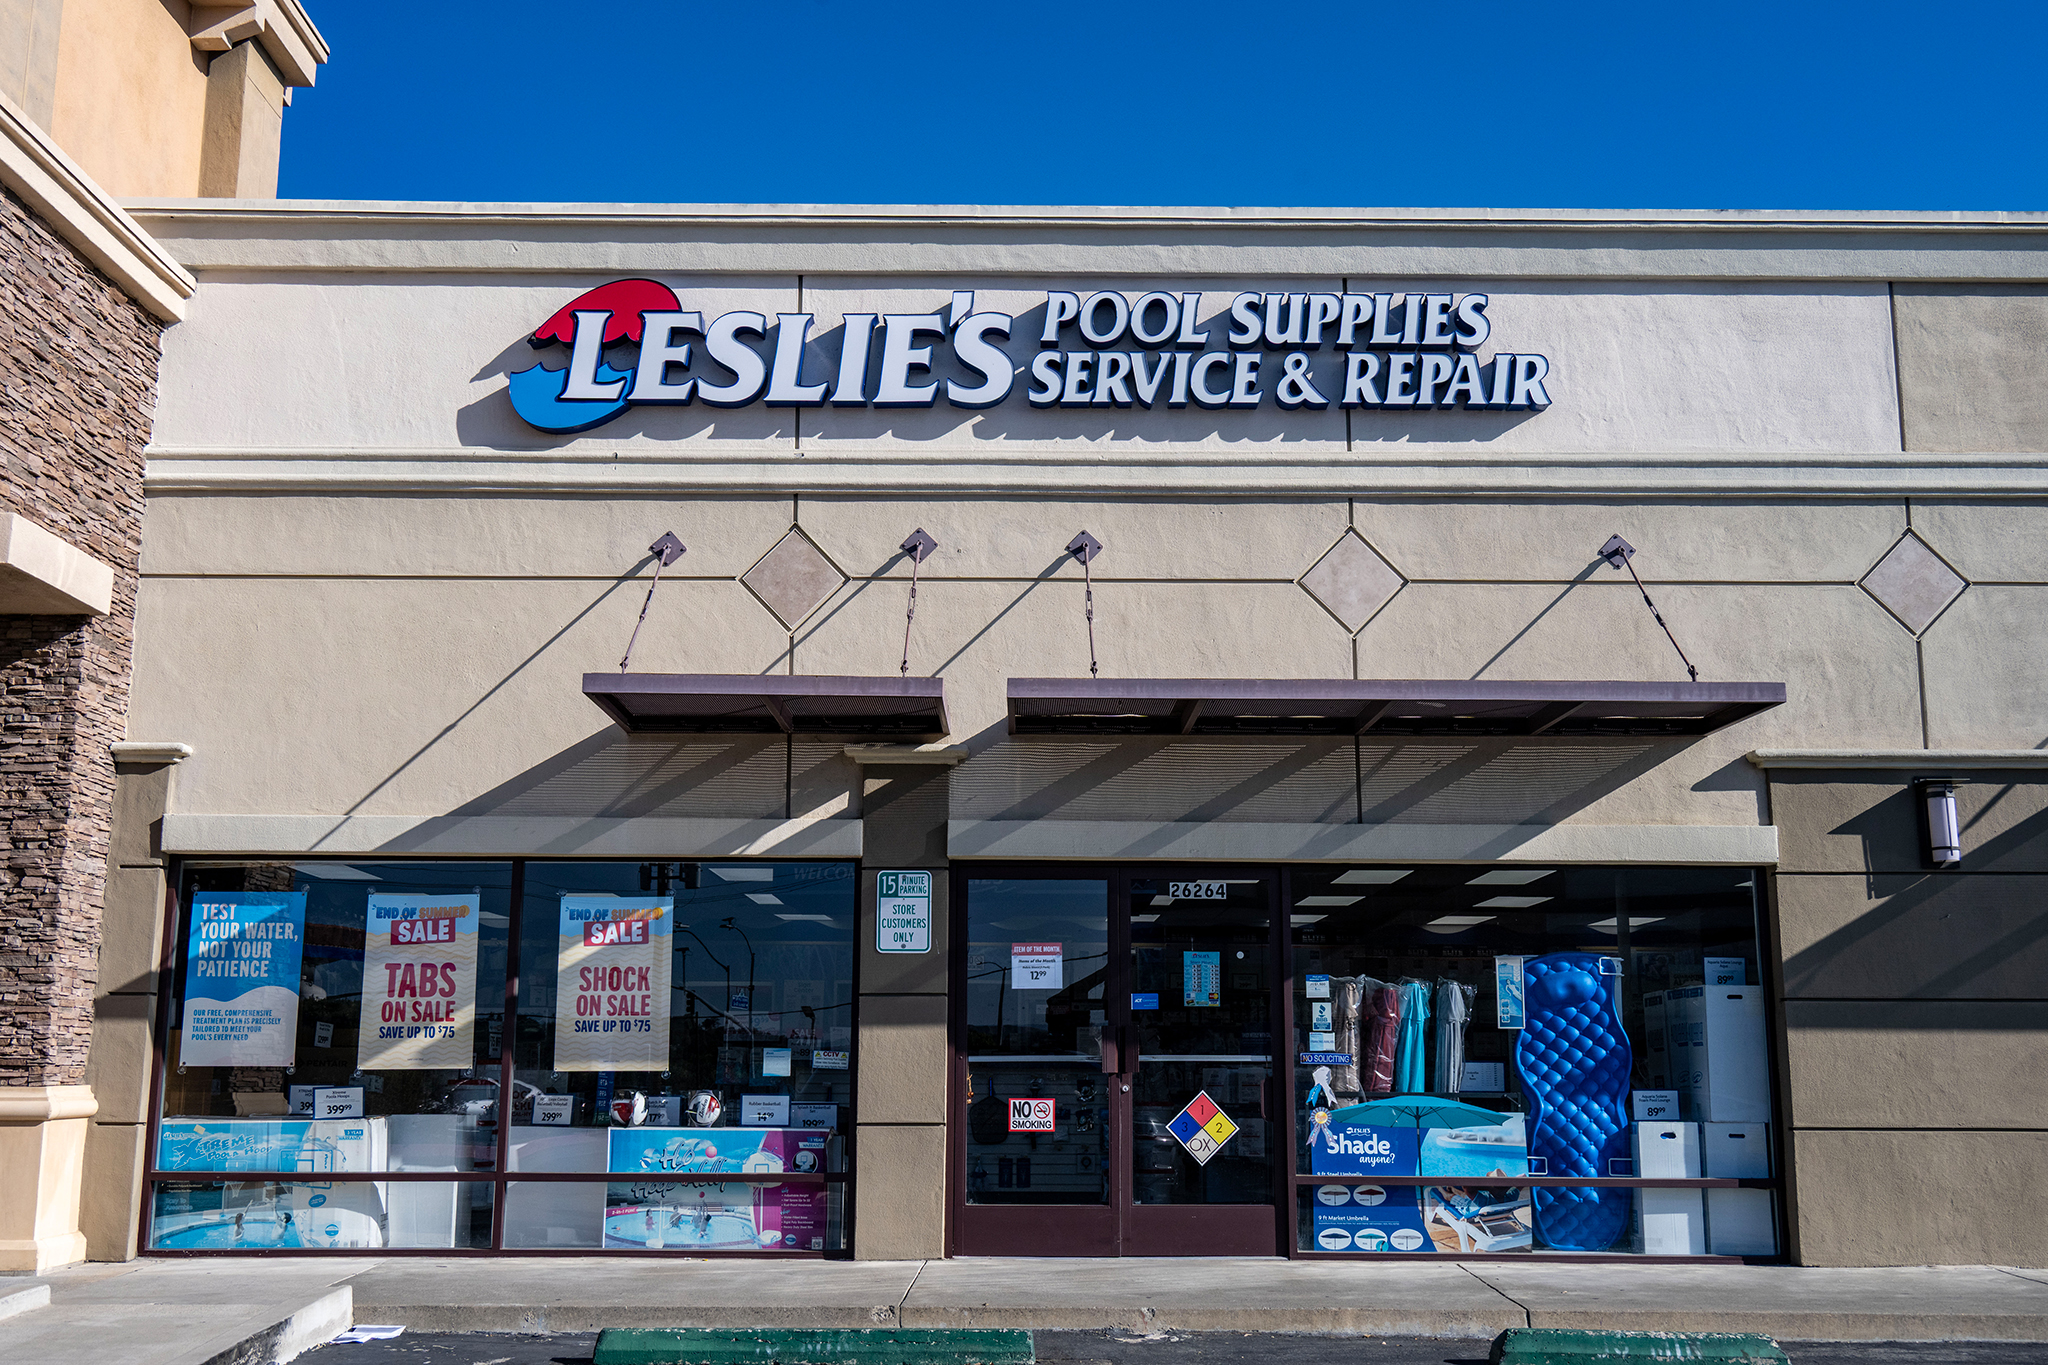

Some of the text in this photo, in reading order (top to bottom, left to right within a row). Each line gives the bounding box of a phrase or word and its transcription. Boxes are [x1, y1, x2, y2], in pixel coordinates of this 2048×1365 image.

[1040, 291, 1491, 350] POOL SUPPLIES
[558, 290, 1016, 409] LESLIE'S
[1028, 350, 1553, 411] SERVICE & REPAIR
[882, 875, 925, 894] 15 MINUTE
[900, 885, 927, 894] PARKING
[1171, 883, 1226, 898] 26264
[201, 903, 238, 920] TEST
[376, 906, 466, 920] END OF SUMMER
[568, 908, 660, 922] END OF SUMMER
[892, 904, 916, 915] STORE
[881, 918, 927, 929] CUSTOMERS
[200, 921, 299, 942] YOUR WATER,
[397, 919, 450, 943] SALE
[590, 921, 643, 944] SALE
[893, 931, 914, 943] ONLY
[198, 940, 272, 958] NOT YOUR
[197, 960, 270, 978] PATIENCE
[384, 962, 457, 998] TABS
[578, 966, 651, 992] SHOCK
[381, 1000, 456, 1022] ON SALE
[576, 994, 651, 1017] ON SALE
[193, 1009, 273, 1018] OUR FREE, COMPREHENSIVE
[192, 1017, 227, 1025] TREATMENT
[228, 1017, 243, 1025] PLAN
[574, 1019, 651, 1033] SAVE UP TO $75
[192, 1025, 221, 1033] TAILORED
[379, 1025, 455, 1039] SAVE UP TO $75
[191, 1033, 213, 1041] POOL'S
[214, 1033, 232, 1041] EVERY
[1302, 1054, 1350, 1063] NO SOLICITING
[1012, 1101, 1031, 1118] NO
[1200, 1104, 1204, 1115] 1
[1012, 1120, 1052, 1129] SMOKING
[1181, 1121, 1188, 1133] 3
[1215, 1122, 1223, 1134] 2
[1189, 1138, 1211, 1152] OX
[1327, 1133, 1391, 1155] Shade
[1359, 1153, 1396, 1167] anyone?
